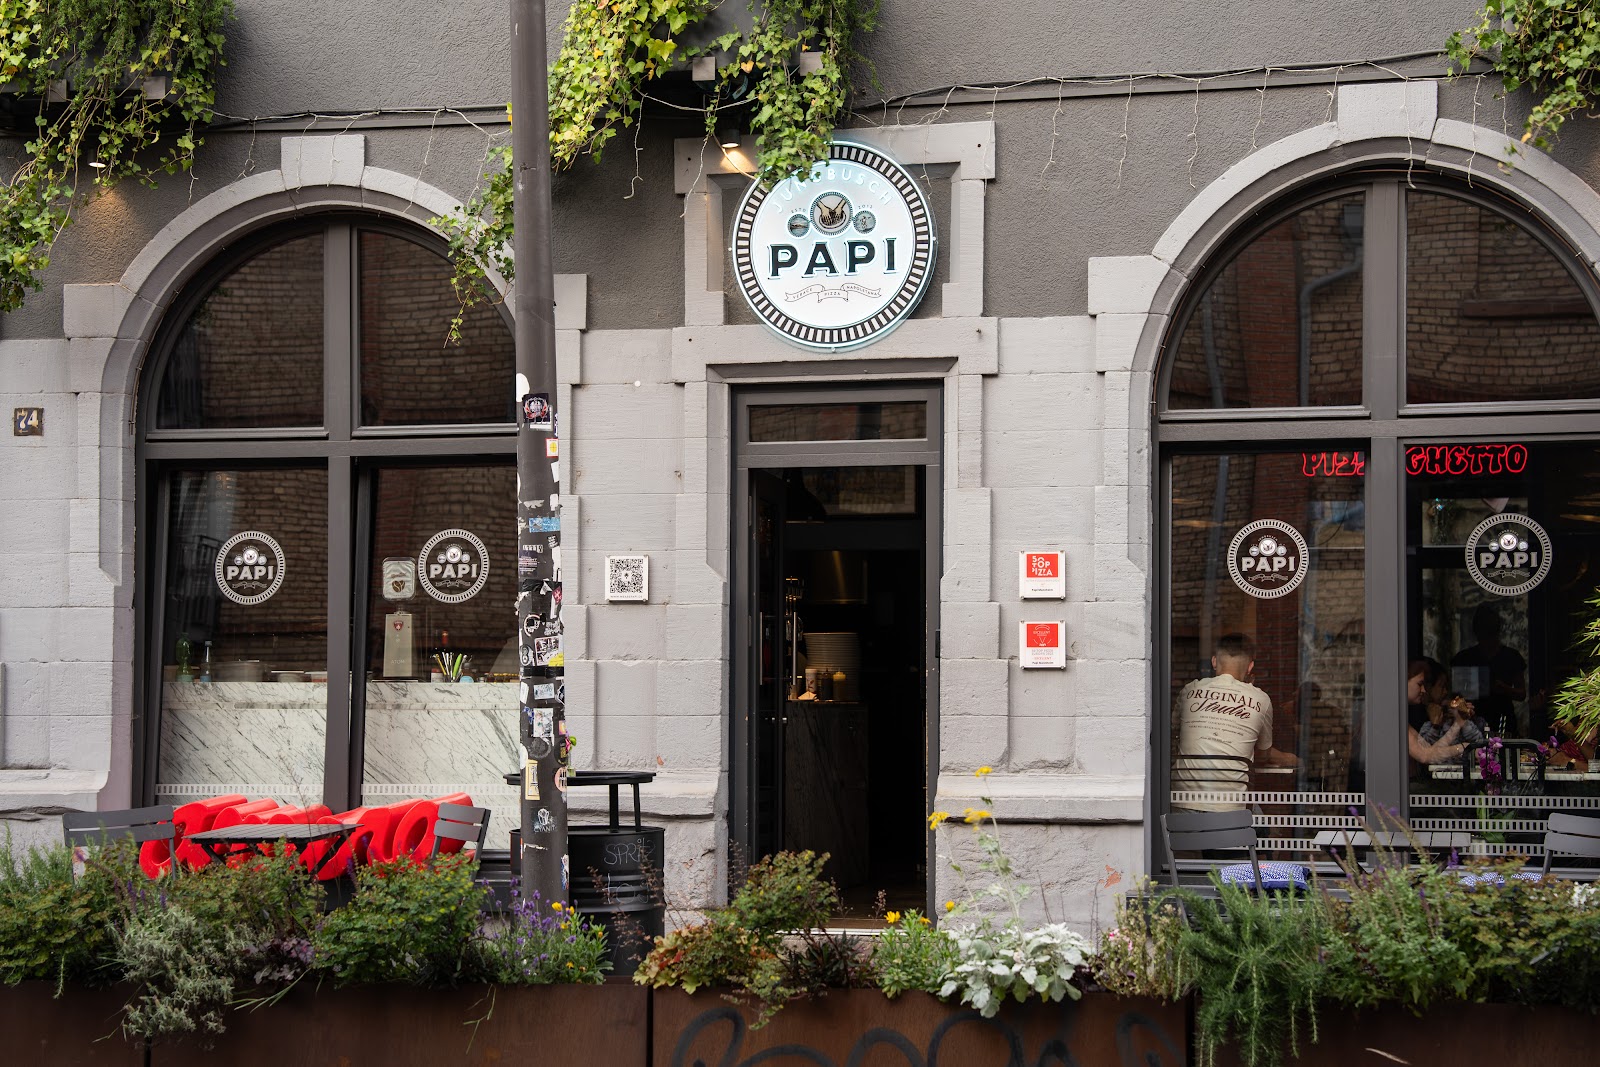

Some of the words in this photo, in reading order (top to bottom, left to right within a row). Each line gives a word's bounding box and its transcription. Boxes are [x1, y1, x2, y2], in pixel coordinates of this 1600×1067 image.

[767, 237, 898, 280] PAPI
[16, 409, 39, 429] 74
[1405, 444, 1528, 476] GHETTO
[1241, 556, 1296, 572] PAPI
[1479, 551, 1538, 569] PAPI
[226, 565, 274, 581] PAPI
[429, 563, 478, 579] PAPI
[1186, 688, 1262, 713] ORIGINALS
[1189, 698, 1251, 719] Studio
